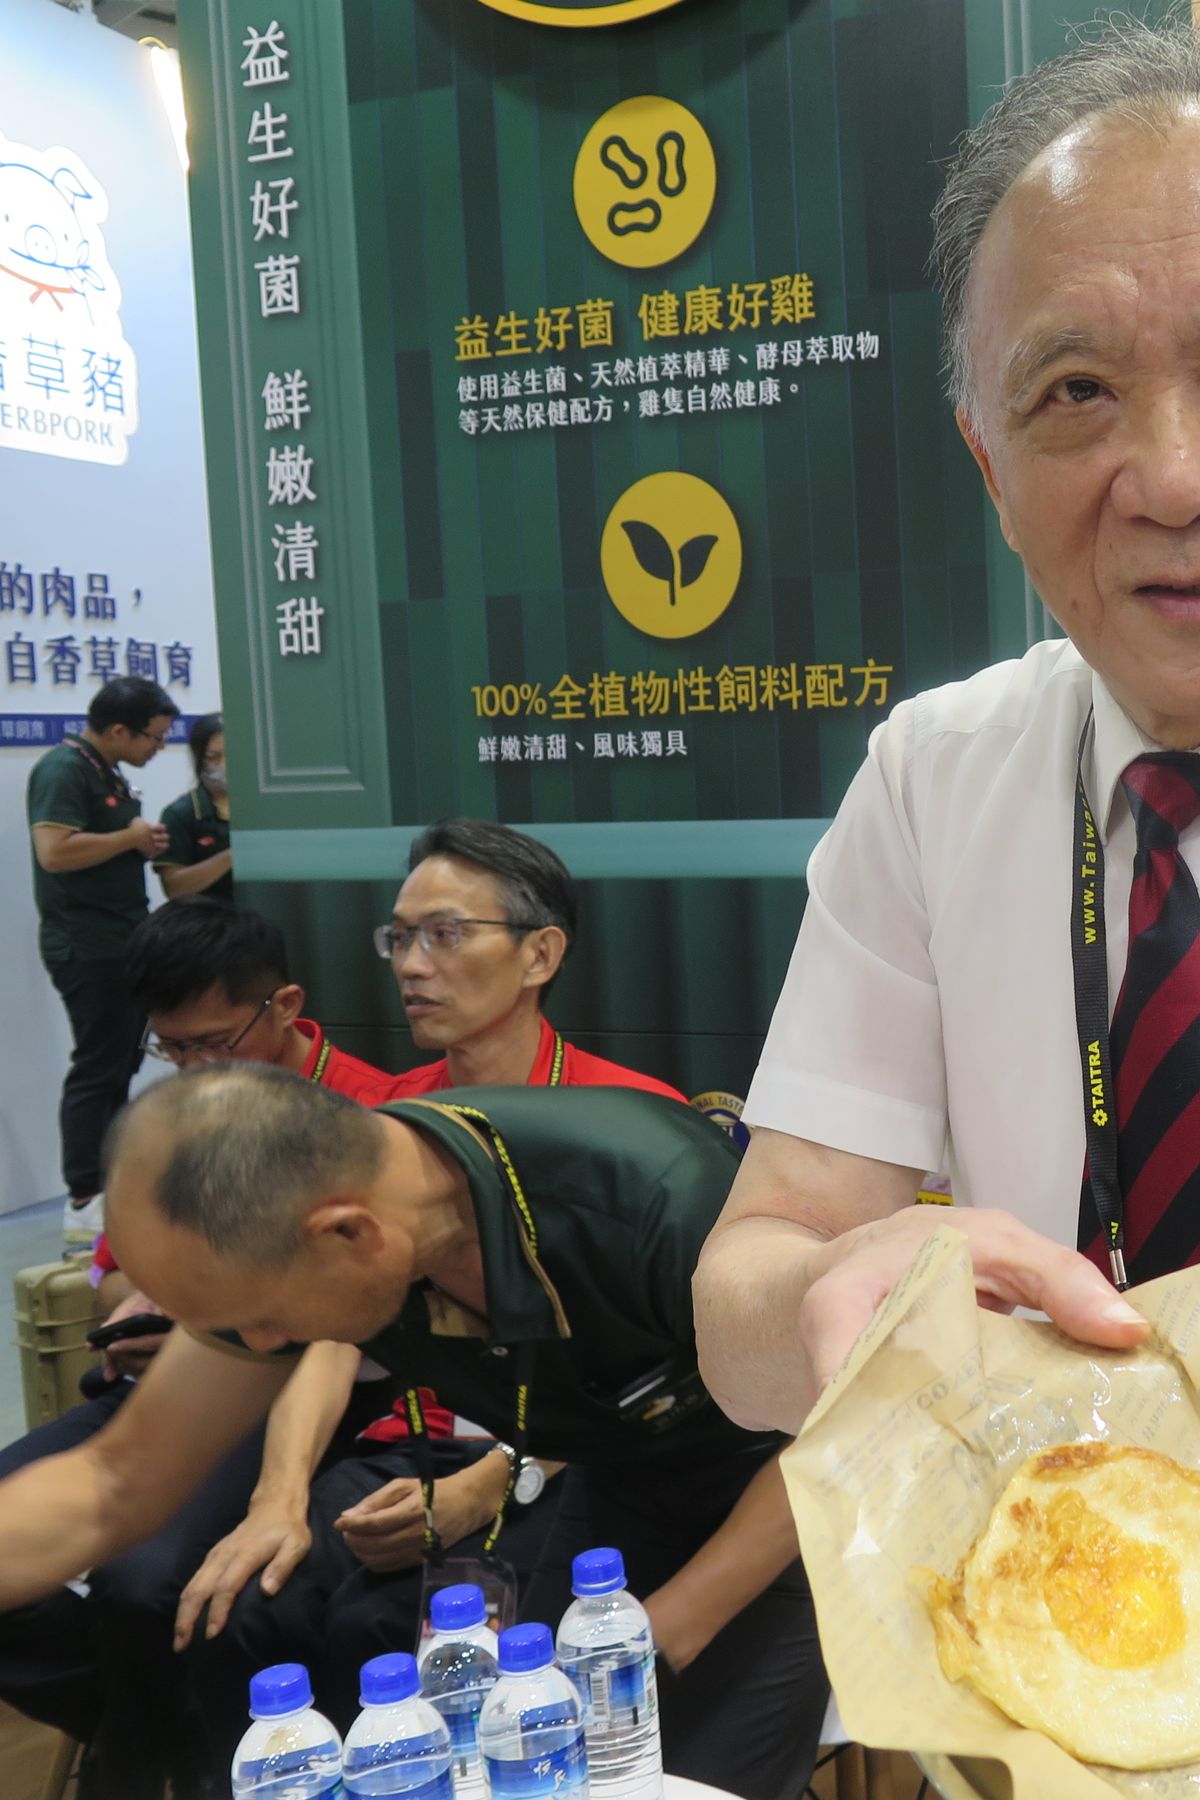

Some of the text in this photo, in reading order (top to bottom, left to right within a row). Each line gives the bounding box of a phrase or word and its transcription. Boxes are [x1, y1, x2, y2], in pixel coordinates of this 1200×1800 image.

[240, 19, 326, 657] 益生好菌 鮮嫩清甜
[454, 272, 817, 362] 益生好菌 健康好雞
[0, 332, 126, 416] 草豬
[471, 658, 894, 721] 100%全植物性飼料配方
[477, 729, 688, 764] 鮮嫩清甜、風味獨具
[1087, 1039, 1105, 1109] TAITRA
